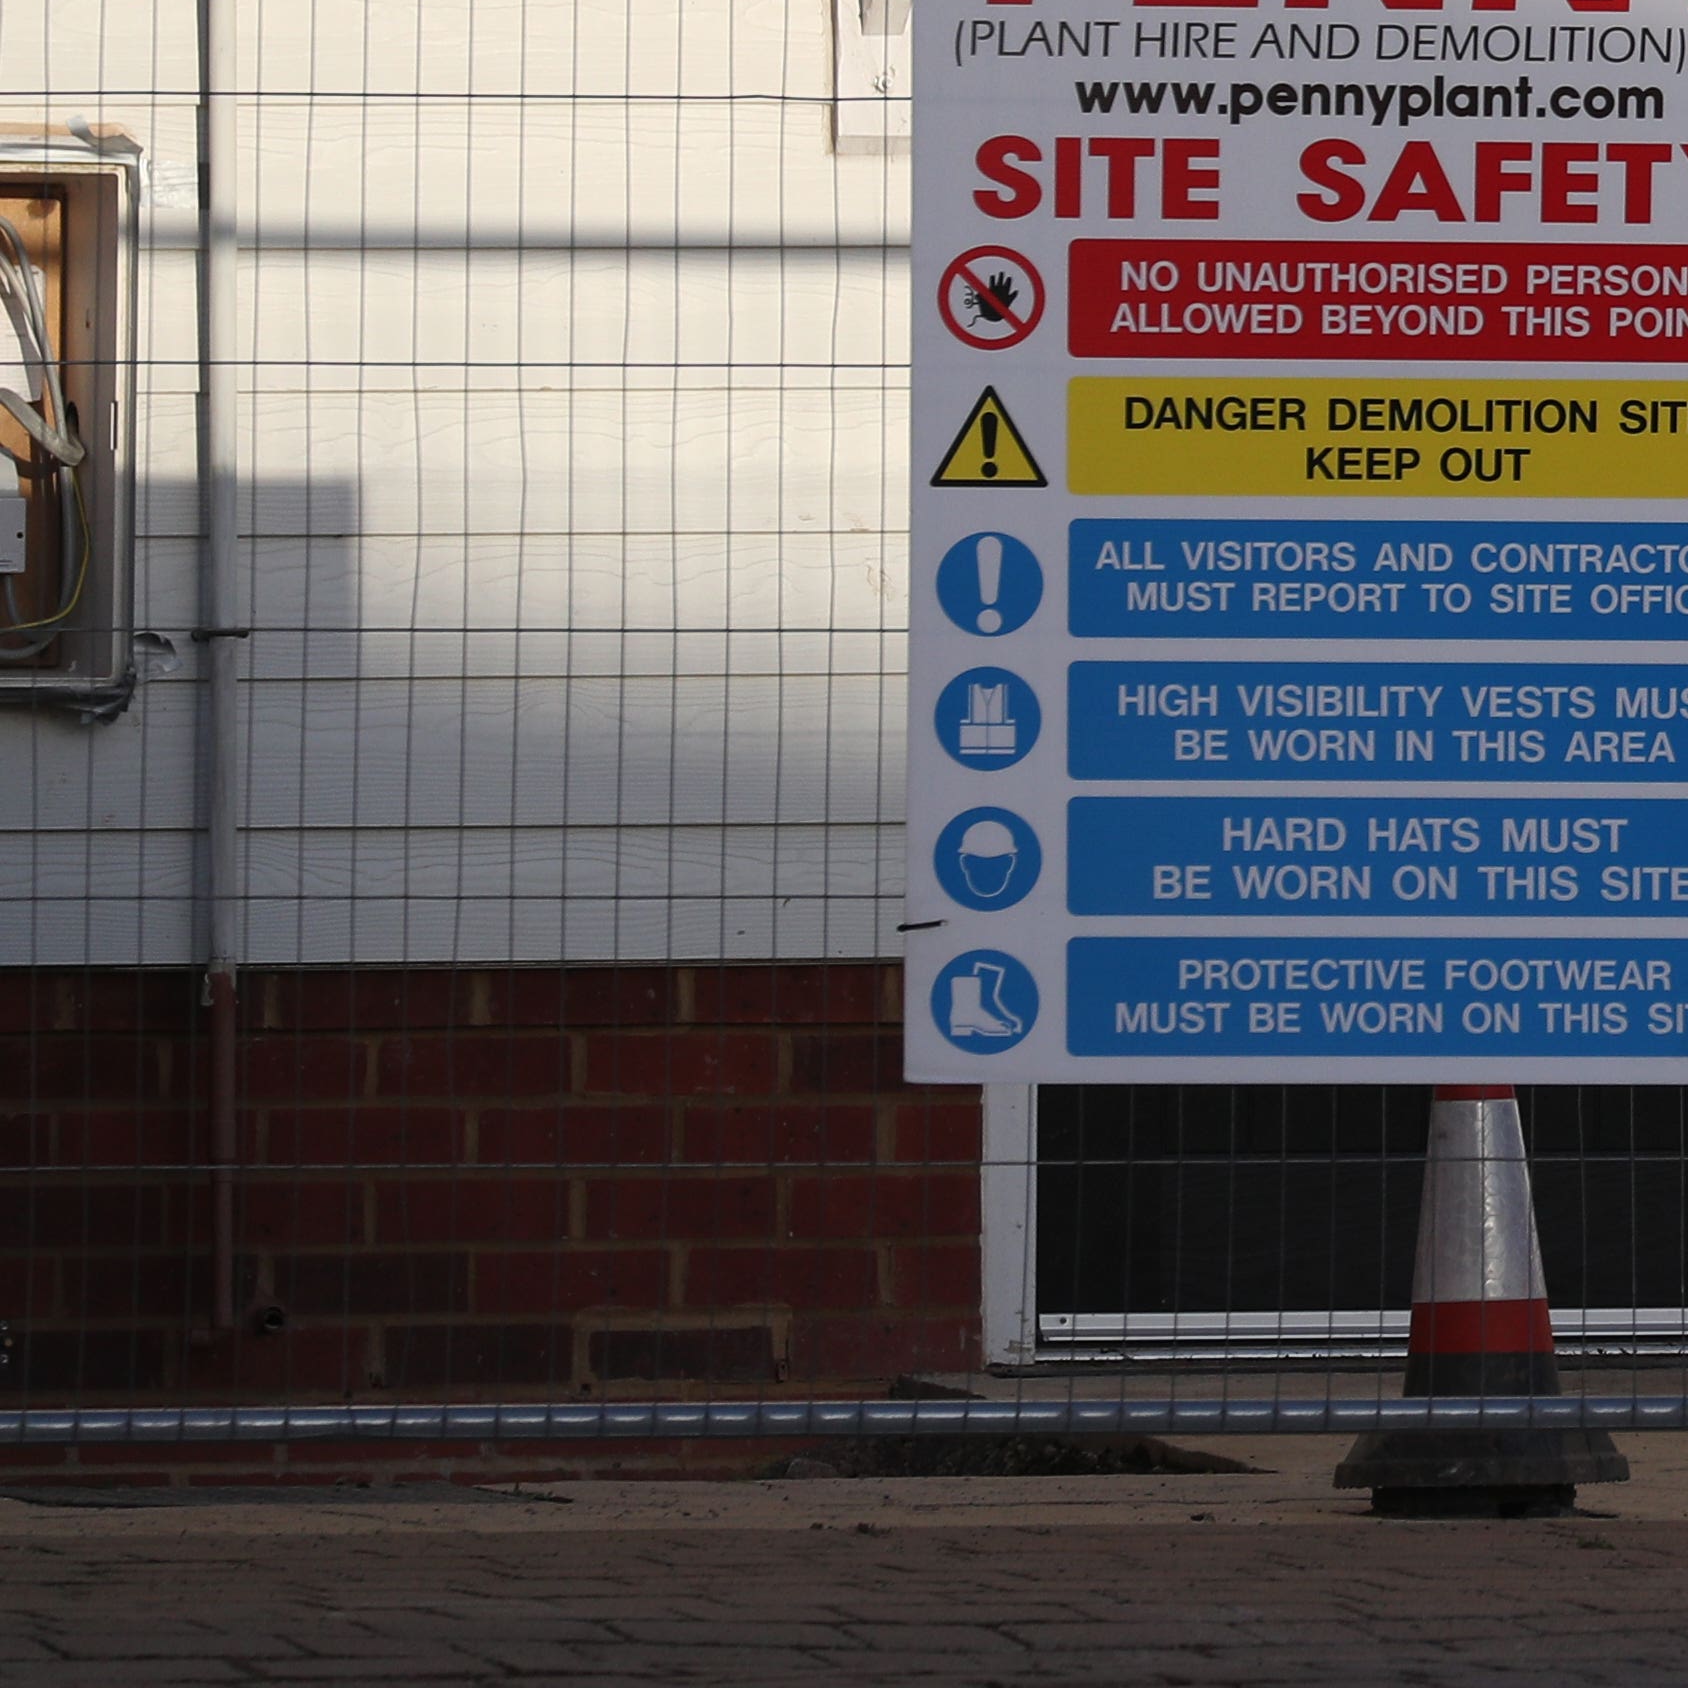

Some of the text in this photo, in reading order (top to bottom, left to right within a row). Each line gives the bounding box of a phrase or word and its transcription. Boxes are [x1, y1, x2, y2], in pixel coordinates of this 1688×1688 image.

[954, 19, 1122, 68] (PLANT
[1134, 21, 1238, 59] HIRE
[1249, 22, 1361, 60] AND
[1375, 24, 1686, 73] DEMOLITION)
[1074, 74, 1664, 127] www.pennyplant.com
[975, 135, 1220, 219] SITE
[1121, 260, 1179, 292] NO
[1198, 261, 1508, 295] UNAUTHORISED
[1110, 302, 1303, 334] ALLOWED
[1322, 304, 1484, 336] BEYOND
[1501, 305, 1590, 337] THIS
[1124, 396, 1306, 432] DANGER
[1328, 397, 1598, 434] DEMOLITION
[1306, 446, 1532, 482] KEEP OUT
[1095, 541, 1165, 570] ALL
[1181, 540, 1356, 572] VISITORS
[1373, 542, 1453, 572] AND
[1127, 581, 1236, 612] MUST
[1252, 582, 1406, 613] REPORT
[1421, 583, 1472, 613] TO
[1490, 583, 1572, 614] SITE
[1118, 684, 1218, 717] HIGH
[1237, 684, 1443, 718] VISIBILITY
[1461, 685, 1596, 719] VESTS
[1175, 729, 1676, 763] BE WORN IN THIS AREA
[1223, 817, 1628, 854] HARD HATS MUST
[1153, 865, 1211, 899] BE
[1233, 864, 1371, 900] WORN
[1392, 865, 1457, 901] ON
[1477, 865, 1579, 901] THIS
[1179, 958, 1671, 991] PROTECTIVE FOOTWEAR
[1116, 1001, 1231, 1034] MUST
[1249, 1002, 1301, 1033] BE
[1320, 1002, 1443, 1034] WORN
[1462, 1002, 1520, 1034] ON
[1538, 1002, 1628, 1035] THIS
